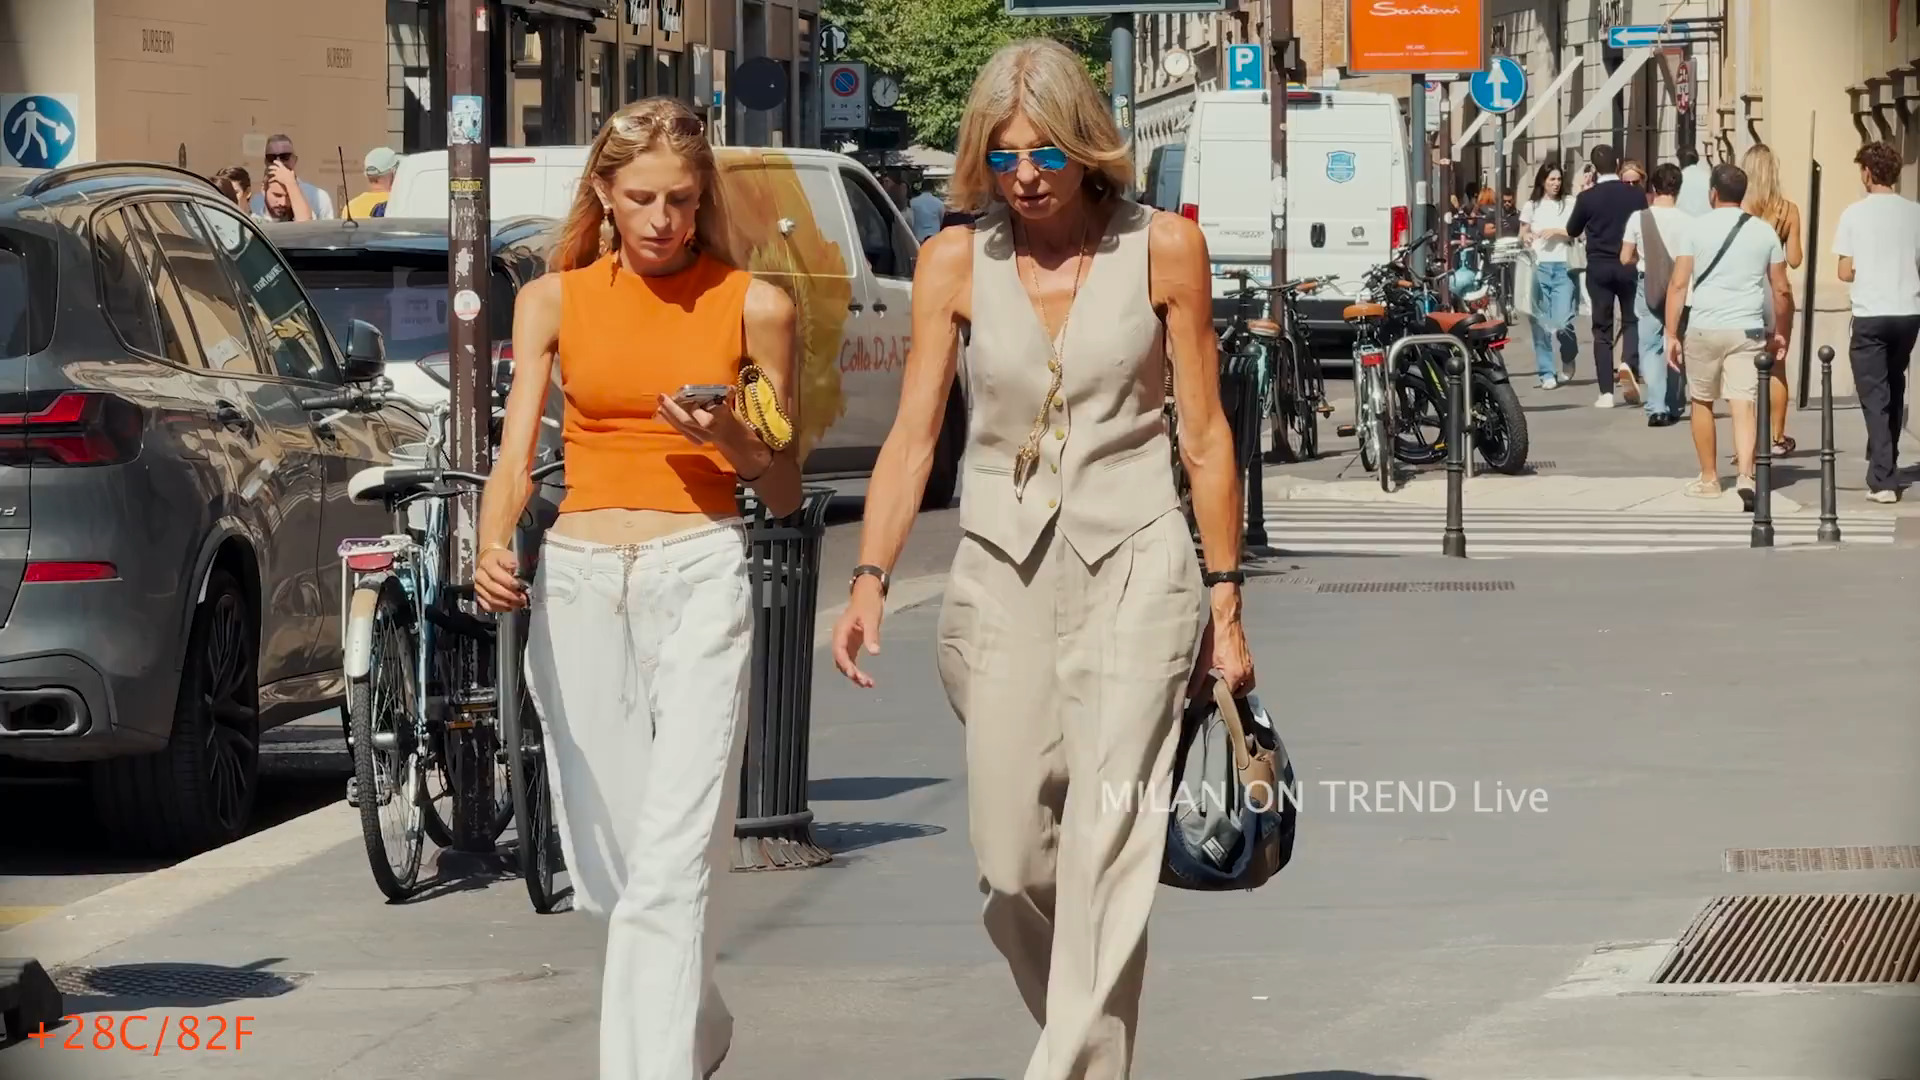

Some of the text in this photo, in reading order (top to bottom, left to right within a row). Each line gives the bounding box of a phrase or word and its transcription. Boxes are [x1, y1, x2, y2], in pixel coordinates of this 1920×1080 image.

[1369, 1, 1461, 16] Santoni
[142, 29, 175, 54] BURBERRY
[326, 47, 353, 69] BURBERRY
[1235, 47, 1254, 72] P
